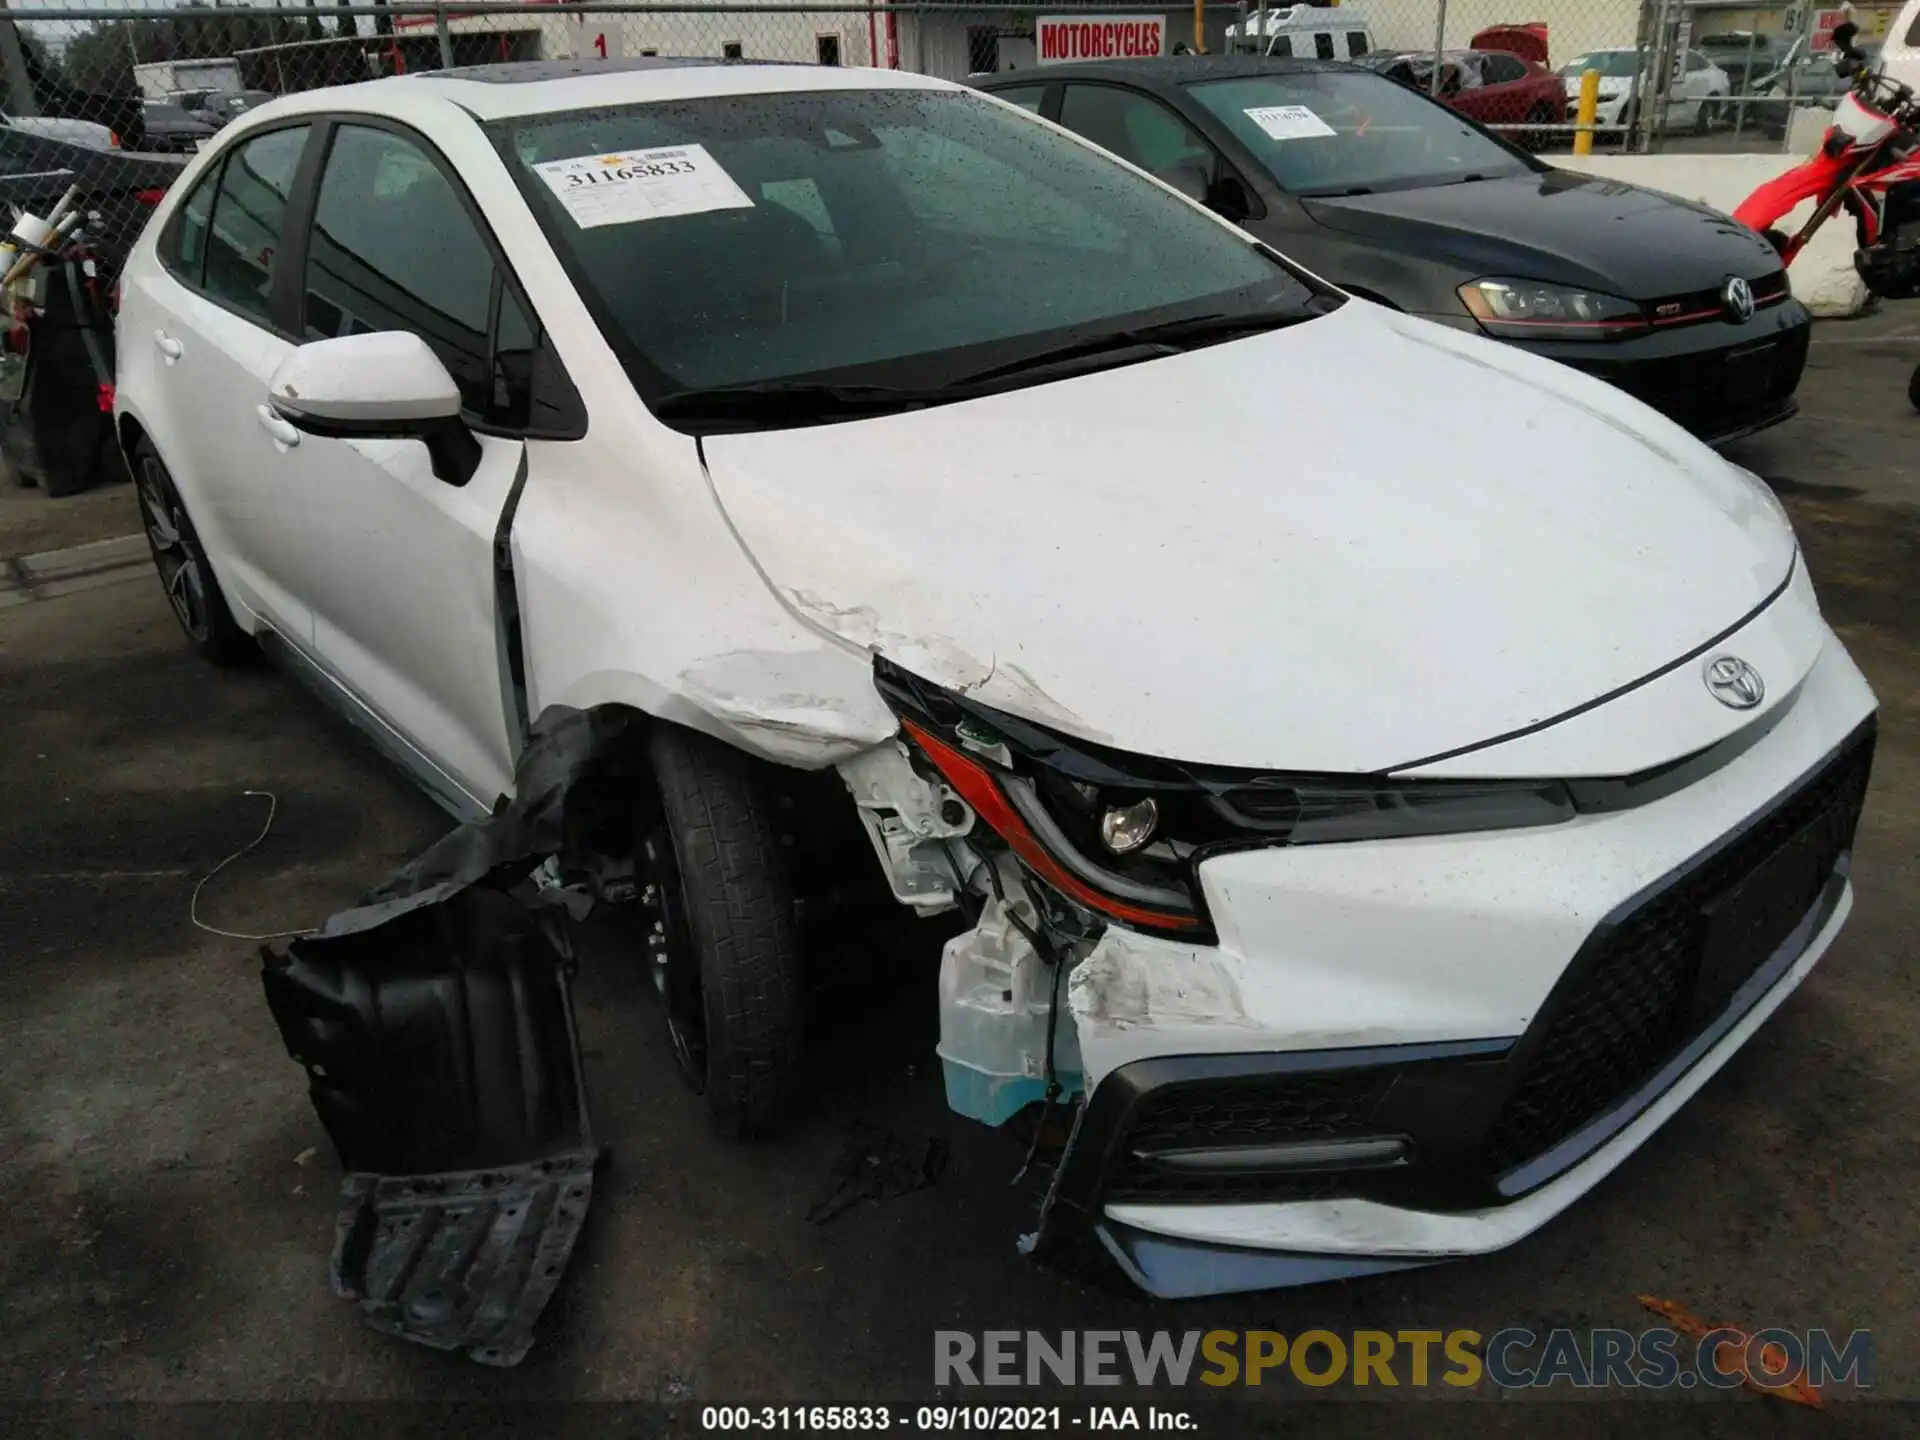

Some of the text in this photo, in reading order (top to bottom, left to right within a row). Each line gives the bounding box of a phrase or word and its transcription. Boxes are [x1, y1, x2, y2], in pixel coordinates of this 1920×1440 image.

[594, 32, 608, 59] 1
[1042, 22, 1160, 58] MOTORCYCLES
[564, 160, 697, 188] 31165833
